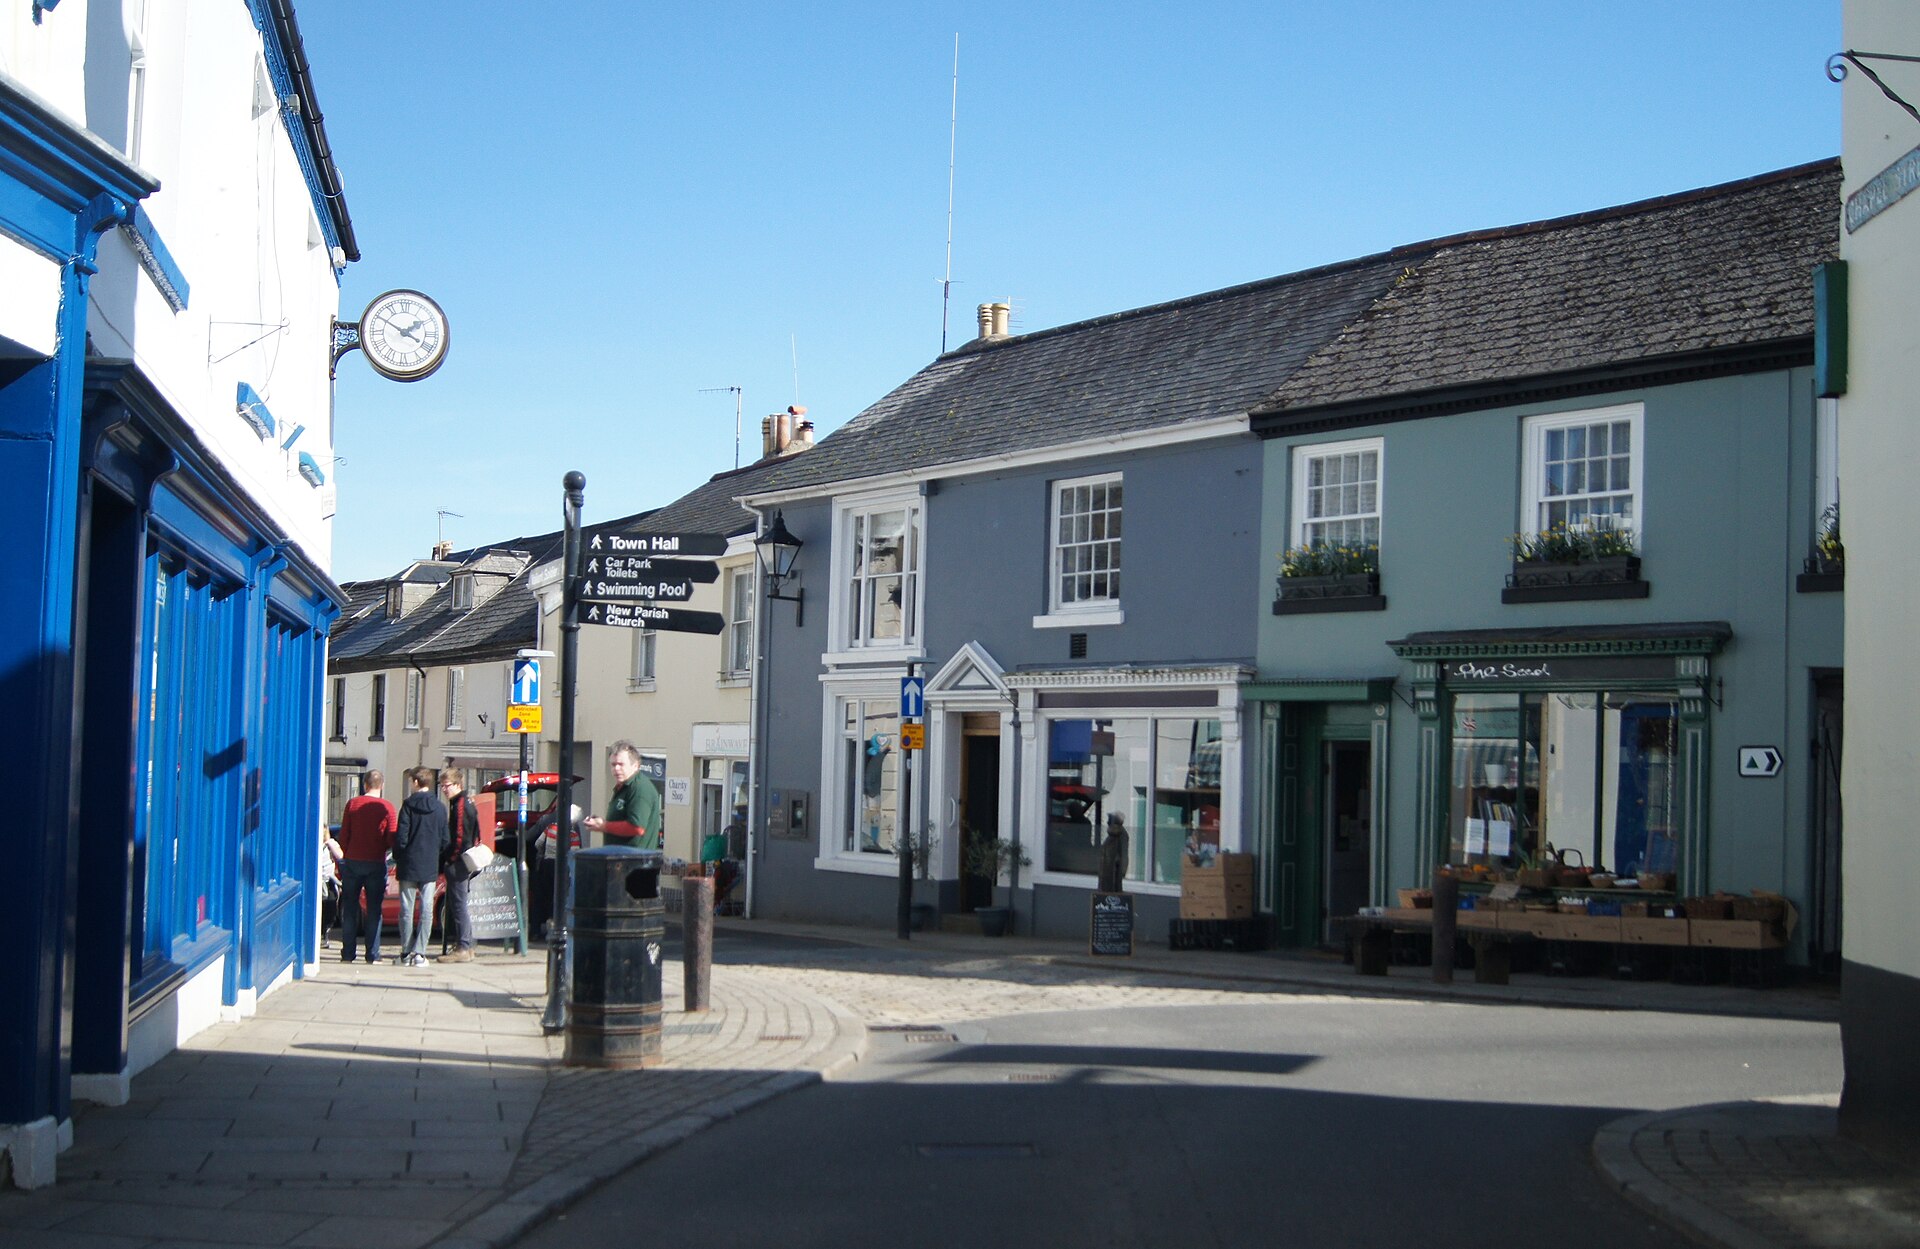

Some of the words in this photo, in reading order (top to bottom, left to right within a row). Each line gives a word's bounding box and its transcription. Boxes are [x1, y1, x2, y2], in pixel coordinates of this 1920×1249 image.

[609, 536, 647, 550] Town
[652, 537, 679, 550] Hall
[605, 557, 624, 568] Car
[628, 558, 652, 569] Park
[605, 567, 638, 578] Toilets
[597, 582, 655, 598] Swimming
[659, 583, 686, 596] Pool
[606, 605, 631, 616] New
[635, 607, 669, 619] Parish
[605, 615, 645, 627] Church
[1500, 663, 1550, 677] Seed
[669, 779, 688, 790] Charity
[671, 791, 683, 803] Shop
